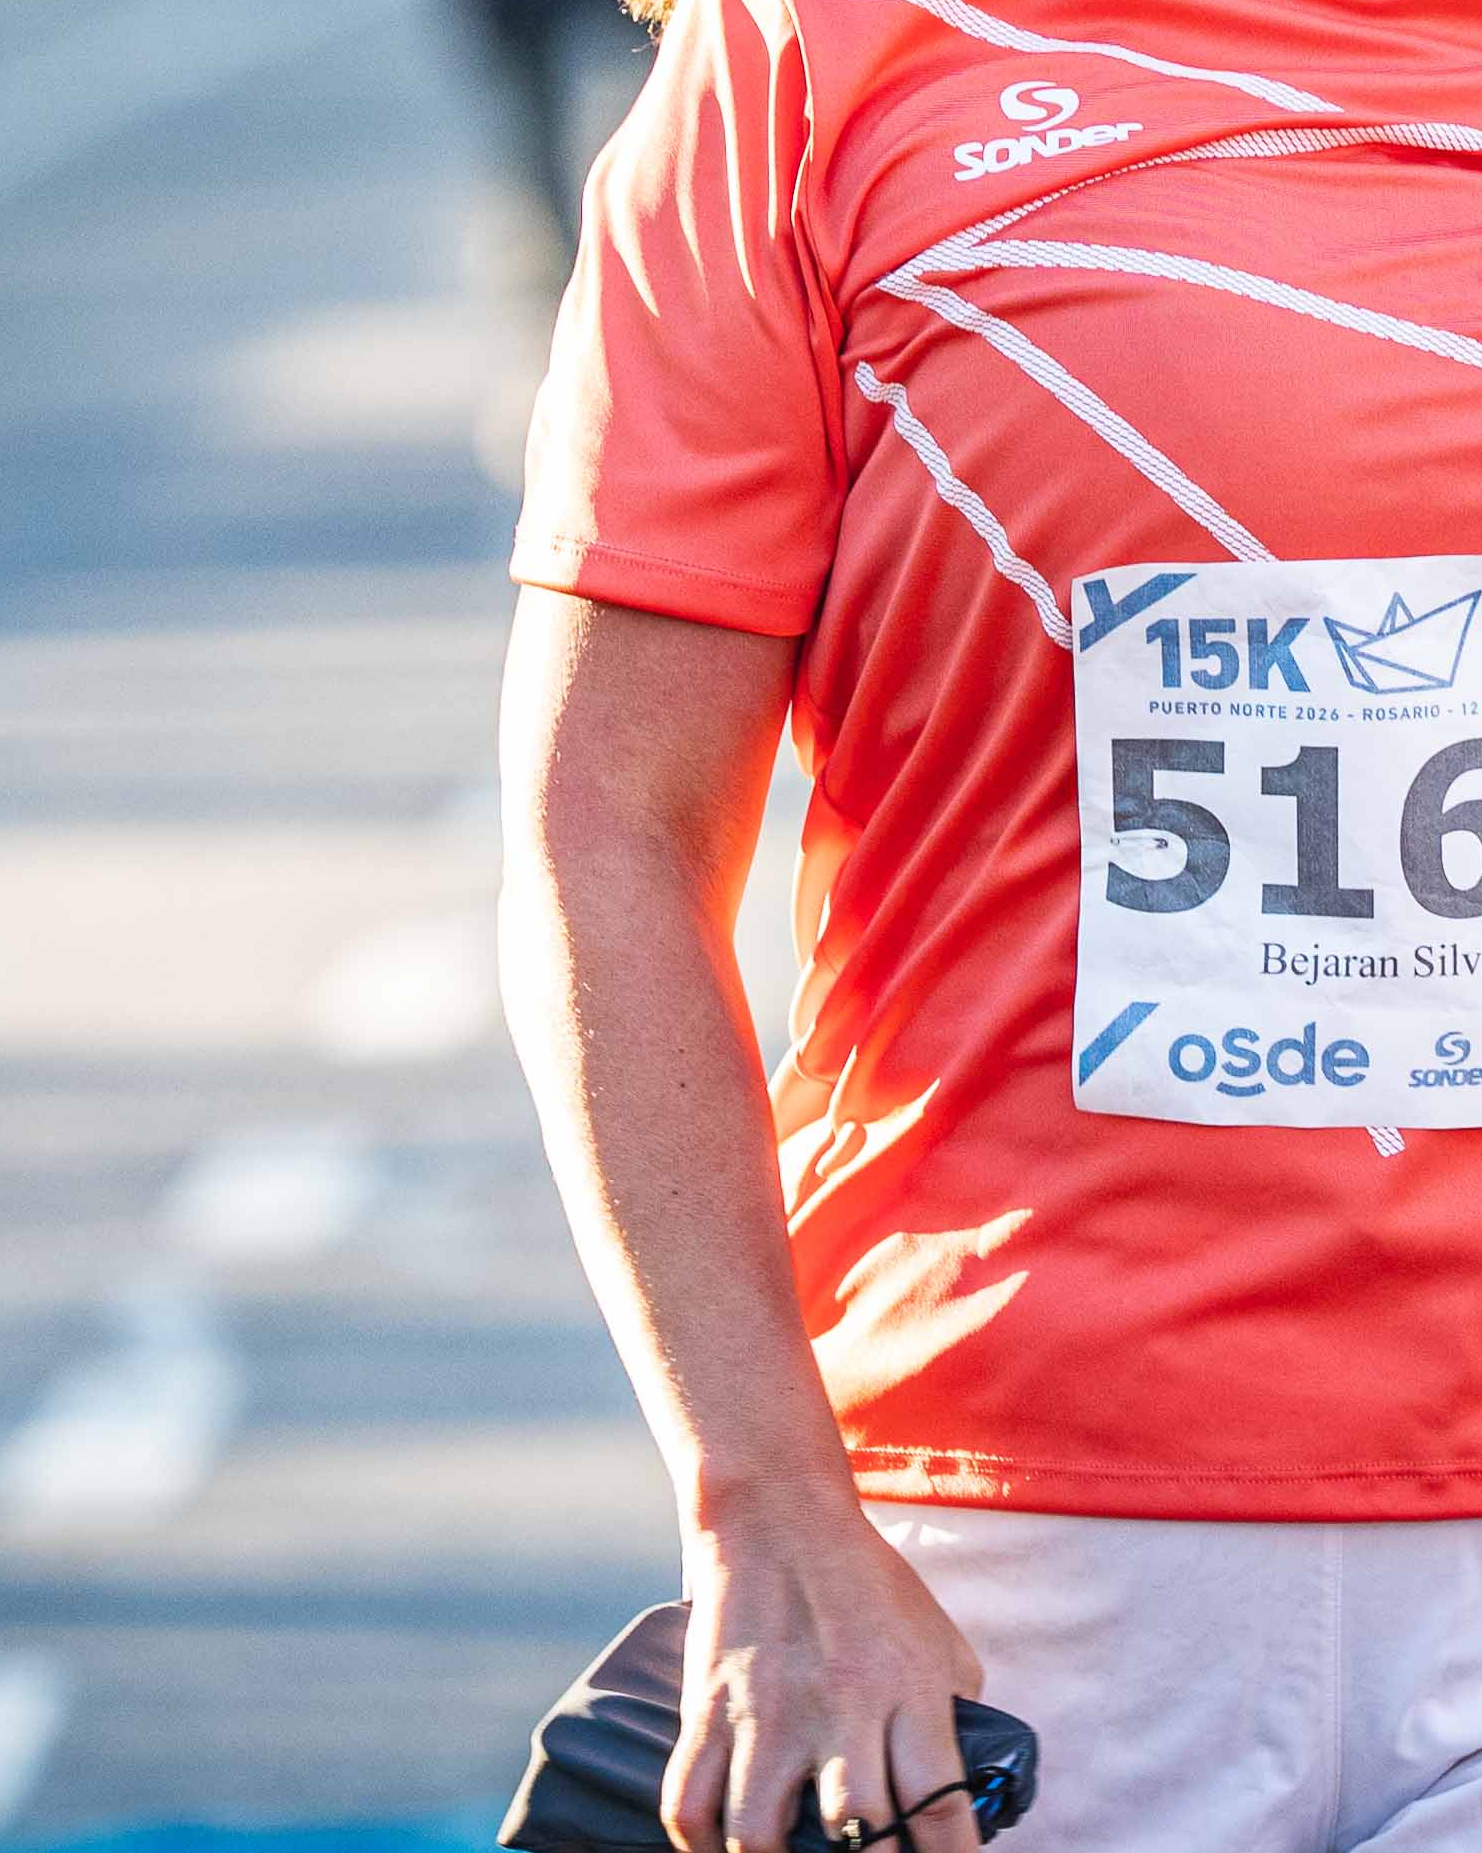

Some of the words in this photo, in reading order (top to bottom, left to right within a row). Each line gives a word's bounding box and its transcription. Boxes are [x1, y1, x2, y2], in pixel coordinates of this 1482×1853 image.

[1145, 617, 1311, 693] 15K
[1148, 700, 1222, 716] PUERTO
[1230, 703, 1288, 719] NORTE
[1295, 706, 1340, 721] 2026
[1362, 704, 1441, 722] ROSARIO
[1461, 701, 1479, 716] 12
[1260, 942, 1399, 986] Bejaran
[1168, 1021, 1370, 1093] osde
